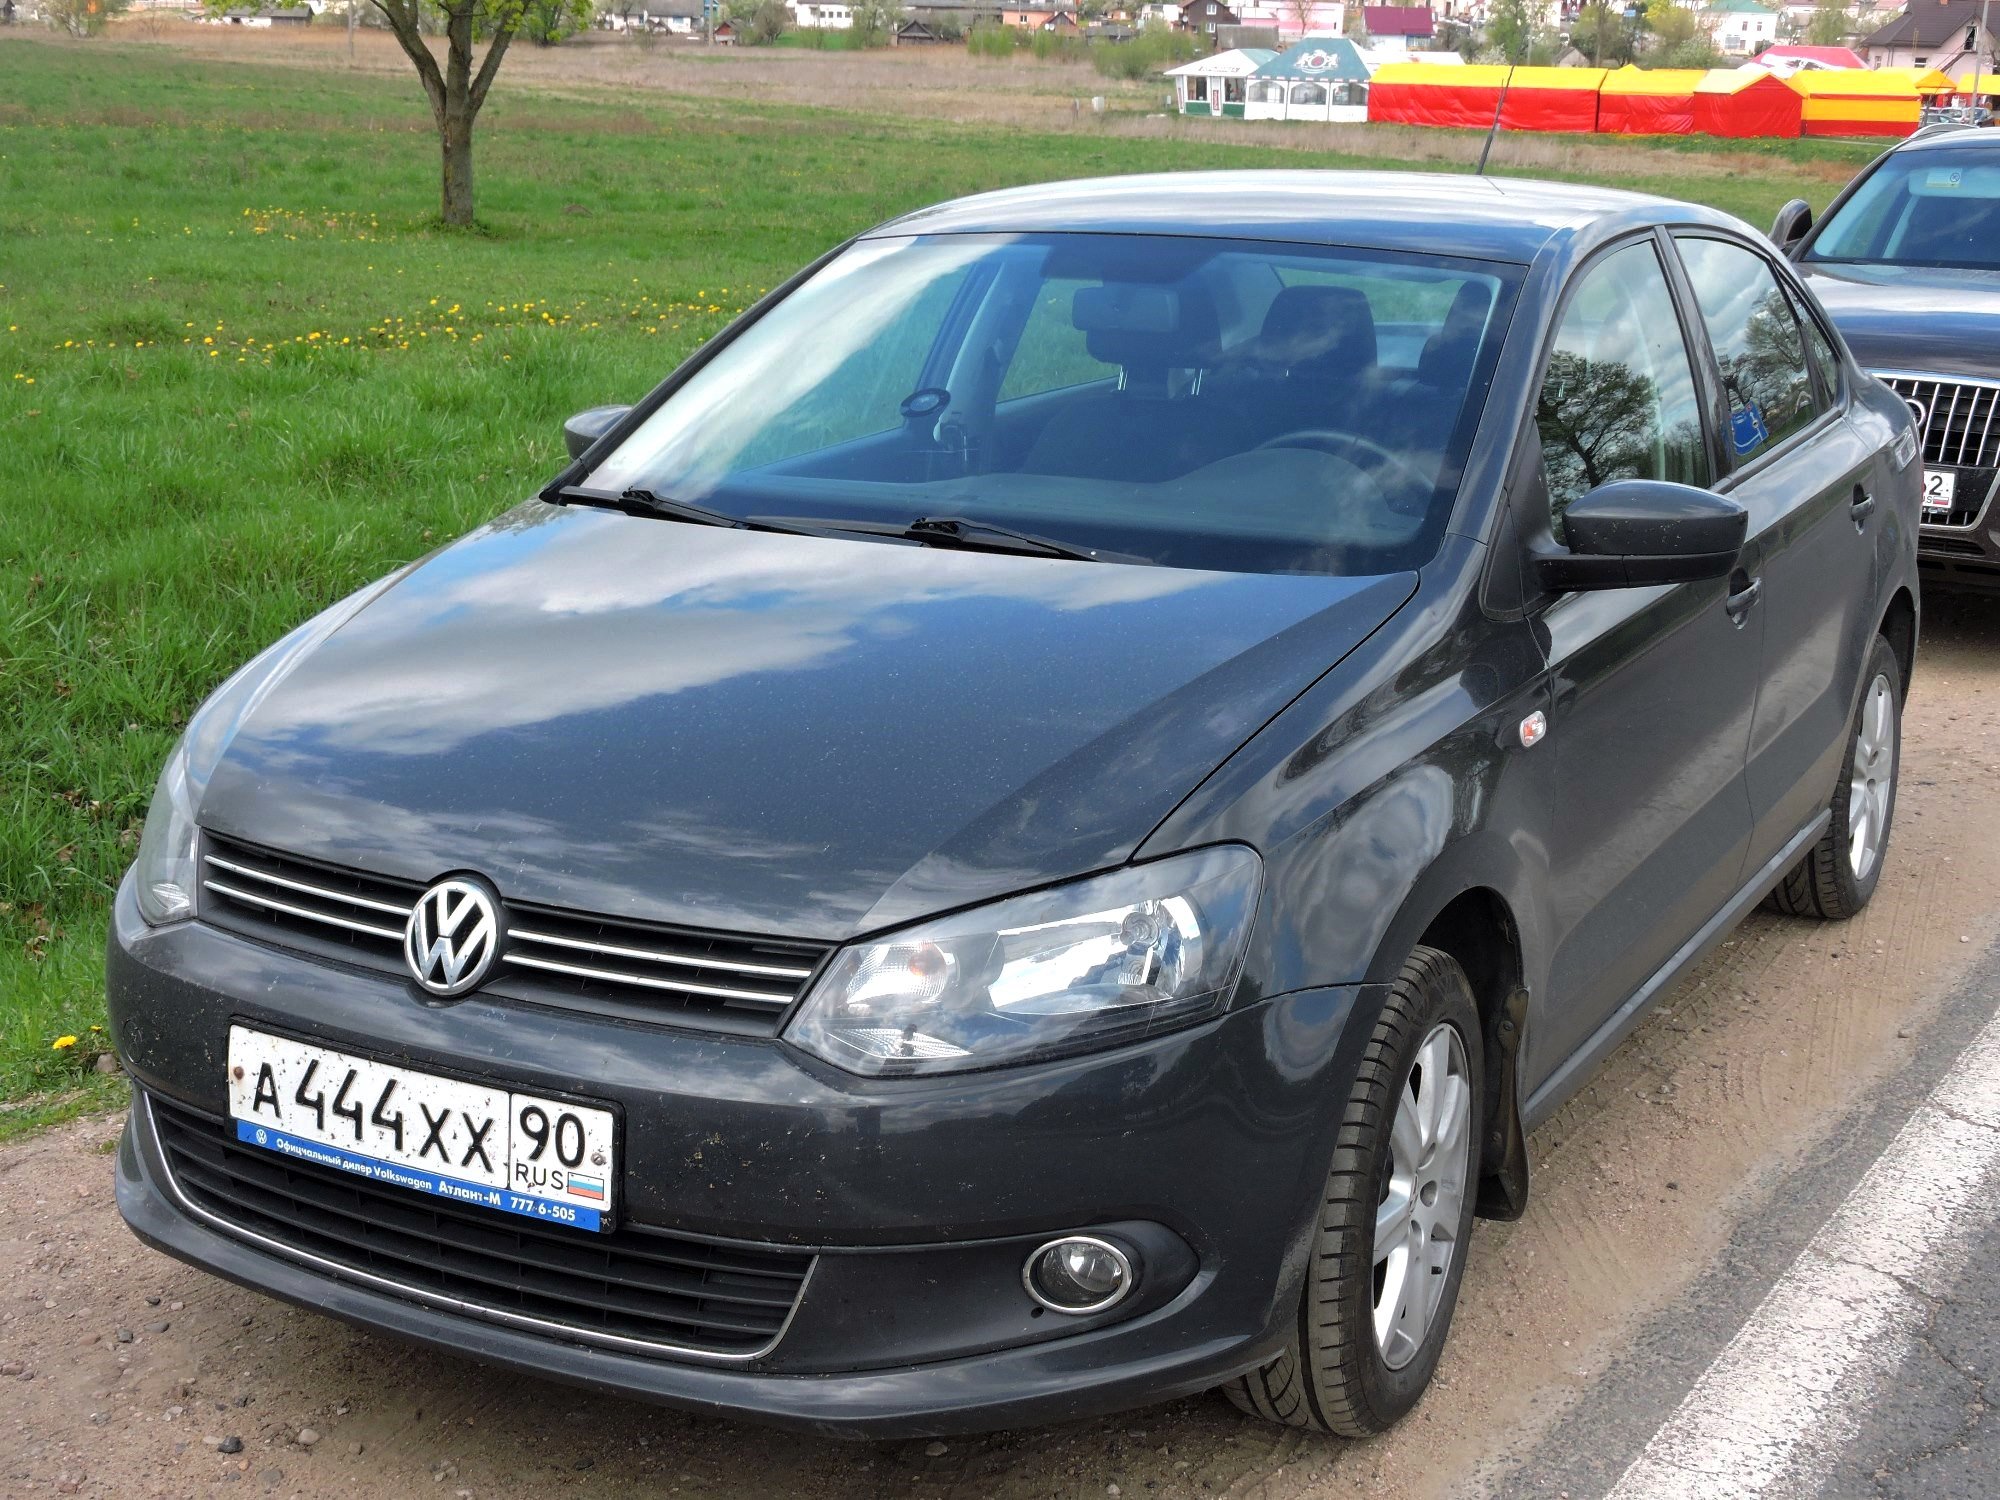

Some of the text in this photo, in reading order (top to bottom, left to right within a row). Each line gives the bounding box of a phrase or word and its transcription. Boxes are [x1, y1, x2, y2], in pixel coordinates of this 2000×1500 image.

[1922, 475, 1943, 496] 2
[519, 1104, 586, 1169] 90
[342, 1160, 373, 1176] дилер
[373, 1166, 432, 1189] Volkswagen
[438, 1180, 501, 1206] Атлант-М
[514, 1162, 564, 1190] RUS
